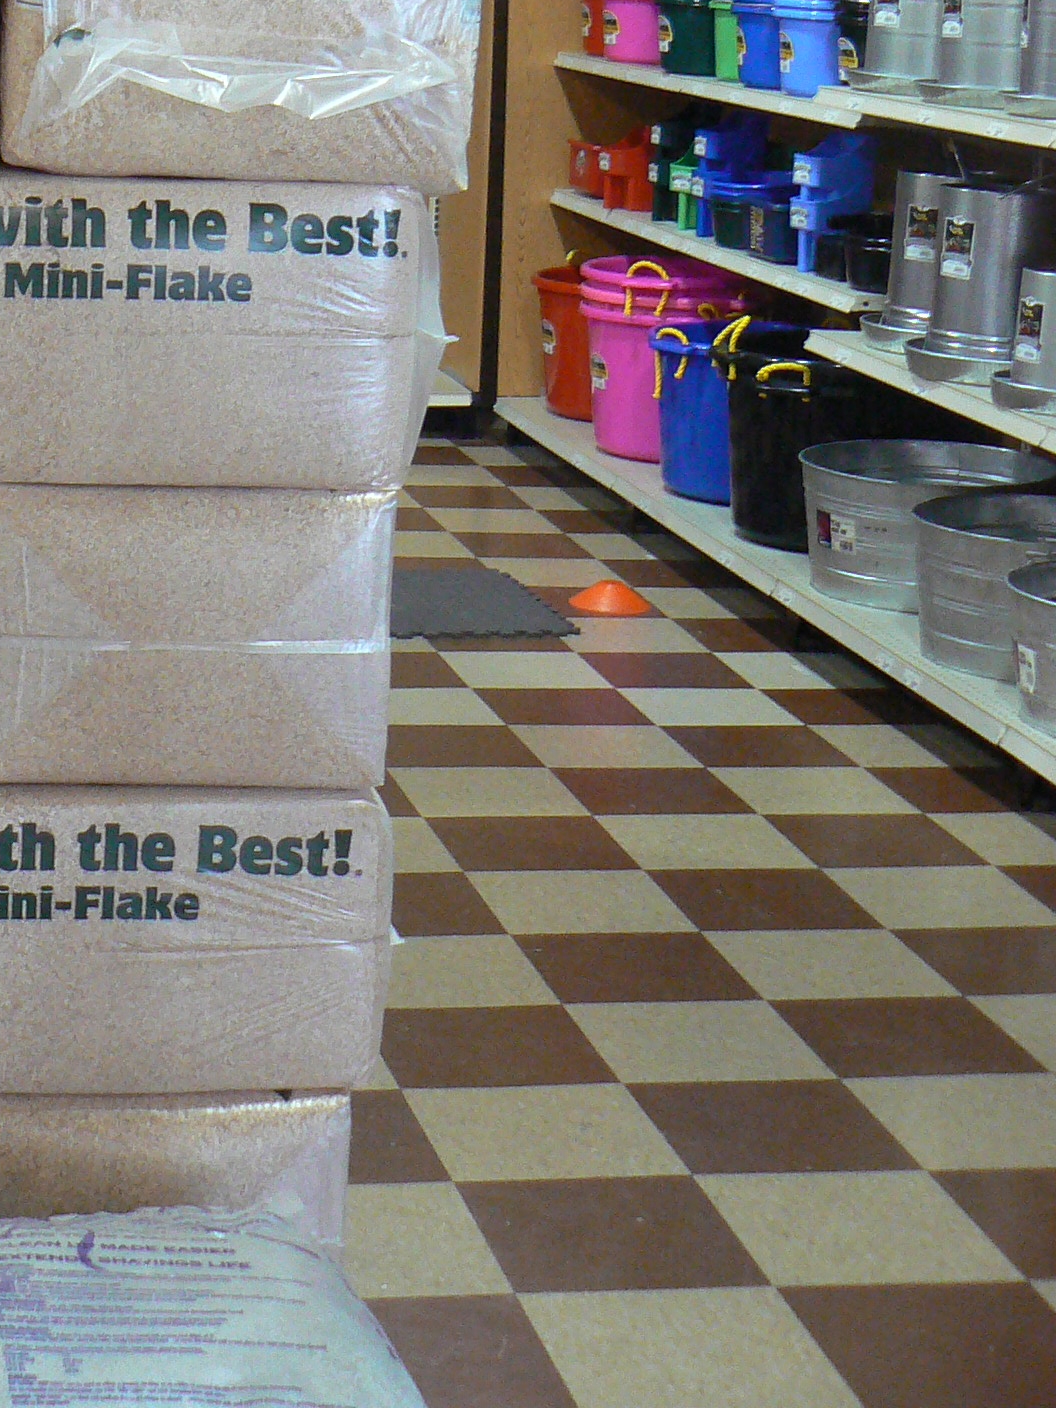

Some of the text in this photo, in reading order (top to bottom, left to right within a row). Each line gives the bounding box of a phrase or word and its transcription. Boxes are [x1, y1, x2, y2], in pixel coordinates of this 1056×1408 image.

[127, 199, 228, 253] the
[4, 262, 253, 302] Mini-Flake
[77, 823, 176, 873] the
